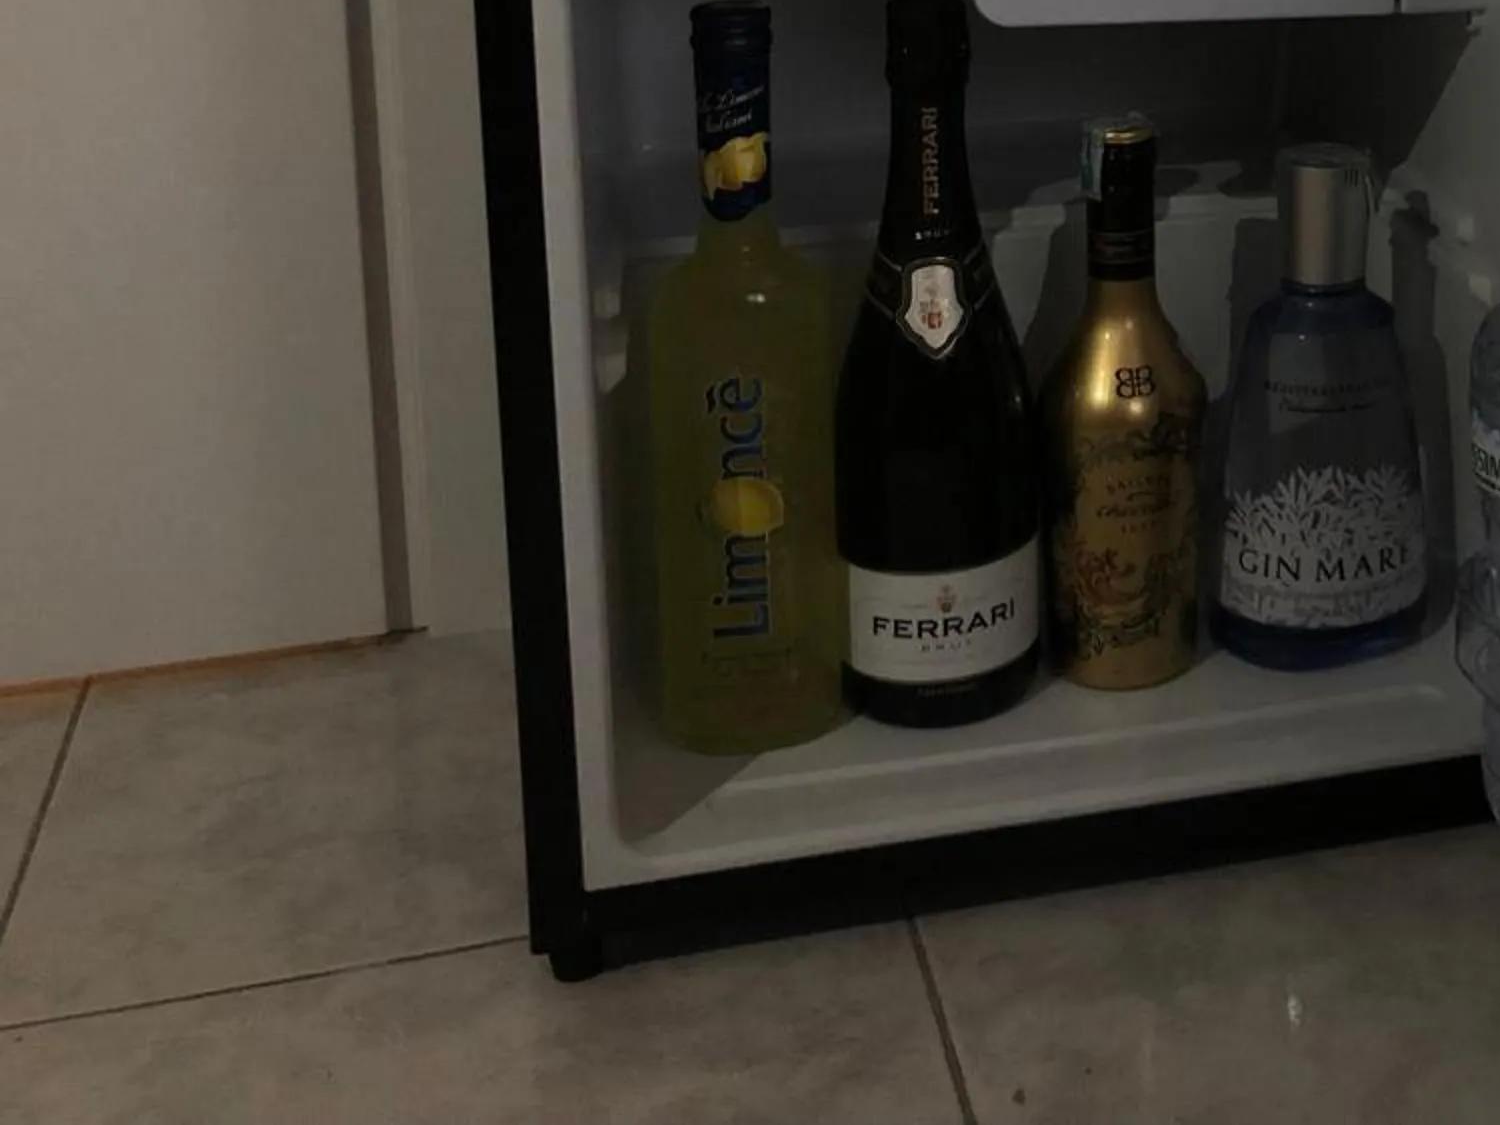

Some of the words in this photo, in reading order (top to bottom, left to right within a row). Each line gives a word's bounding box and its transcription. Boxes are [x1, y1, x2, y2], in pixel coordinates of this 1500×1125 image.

[919, 106, 941, 216] FERRARI
[1239, 548, 1301, 581] GIN
[872, 596, 1015, 639] FERRARI
